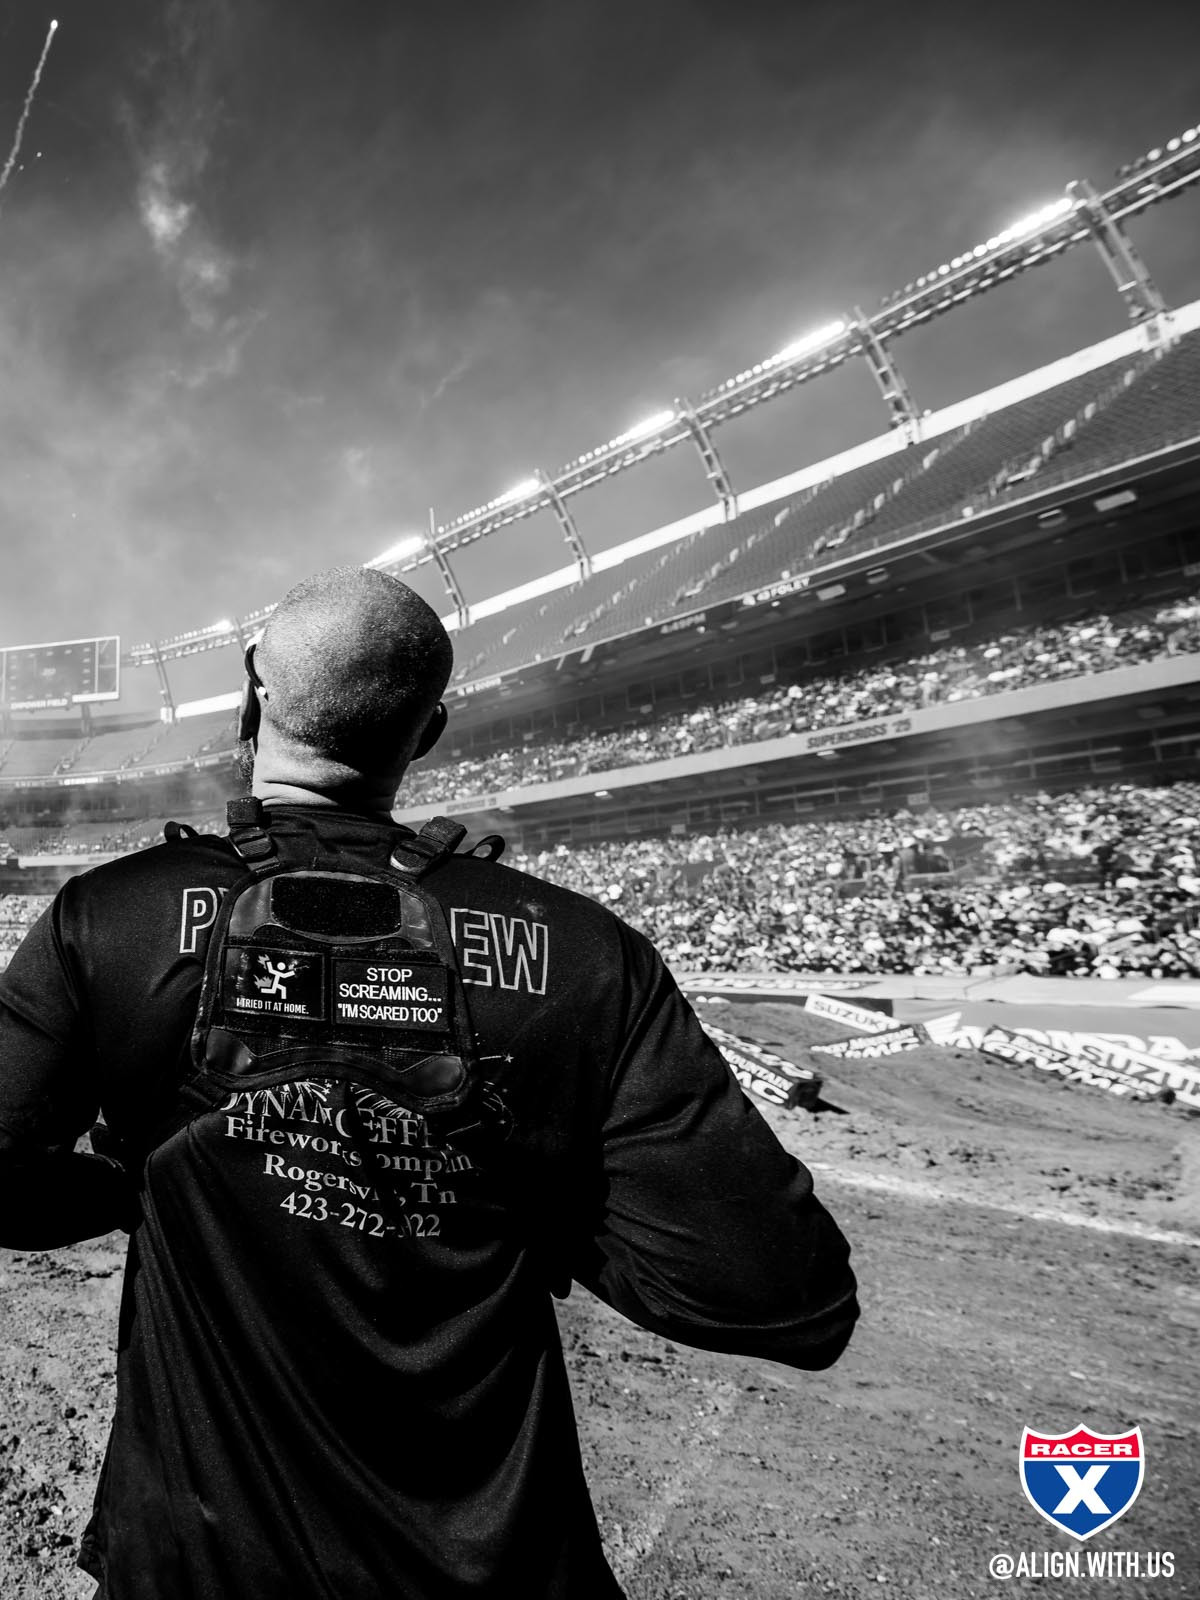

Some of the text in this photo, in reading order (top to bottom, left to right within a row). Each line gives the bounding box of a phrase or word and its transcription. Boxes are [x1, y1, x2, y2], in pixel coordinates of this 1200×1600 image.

[366, 967, 412, 983] STOP
[339, 983, 442, 1002] SCREAMING...
[240, 998, 263, 1010] TRIED
[264, 1000, 273, 1011] IT
[273, 1001, 283, 1012] AT
[283, 1003, 310, 1015] HOME.
[359, 1004, 409, 1021] SCARED
[410, 1007, 443, 1023] TOO"
[814, 1000, 885, 1030] SUZUK
[410, 1182, 457, 1204] Tn
